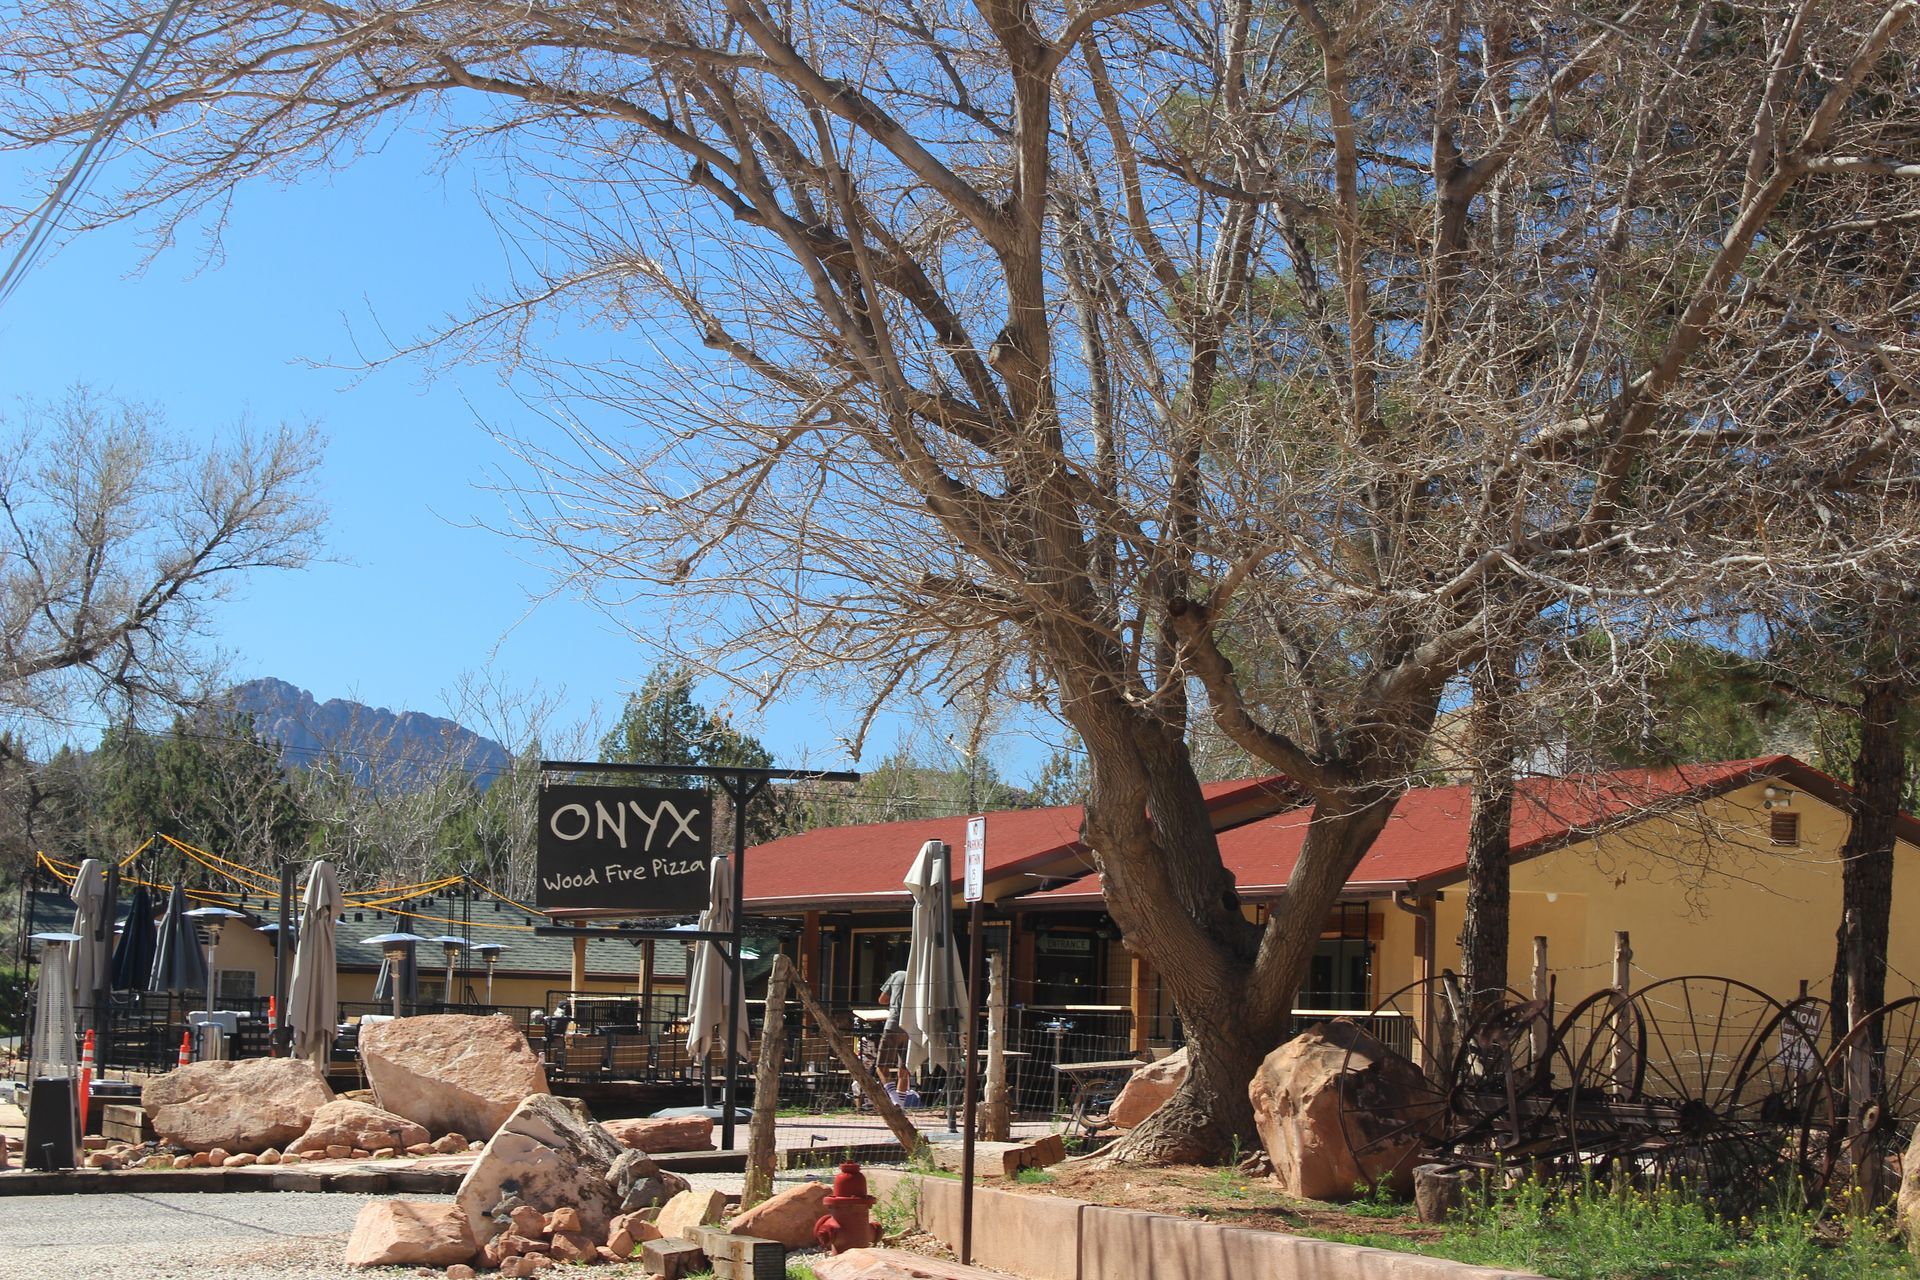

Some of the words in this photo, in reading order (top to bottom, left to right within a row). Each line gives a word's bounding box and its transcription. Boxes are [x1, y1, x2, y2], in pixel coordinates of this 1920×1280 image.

[550, 800, 700, 852] ONYX
[967, 839, 983, 850] PARKING
[543, 868, 599, 891] Wood
[605, 864, 647, 883] Fire
[652, 858, 706, 878] Pizza
[1048, 940, 1087, 949] ENTRANCE
